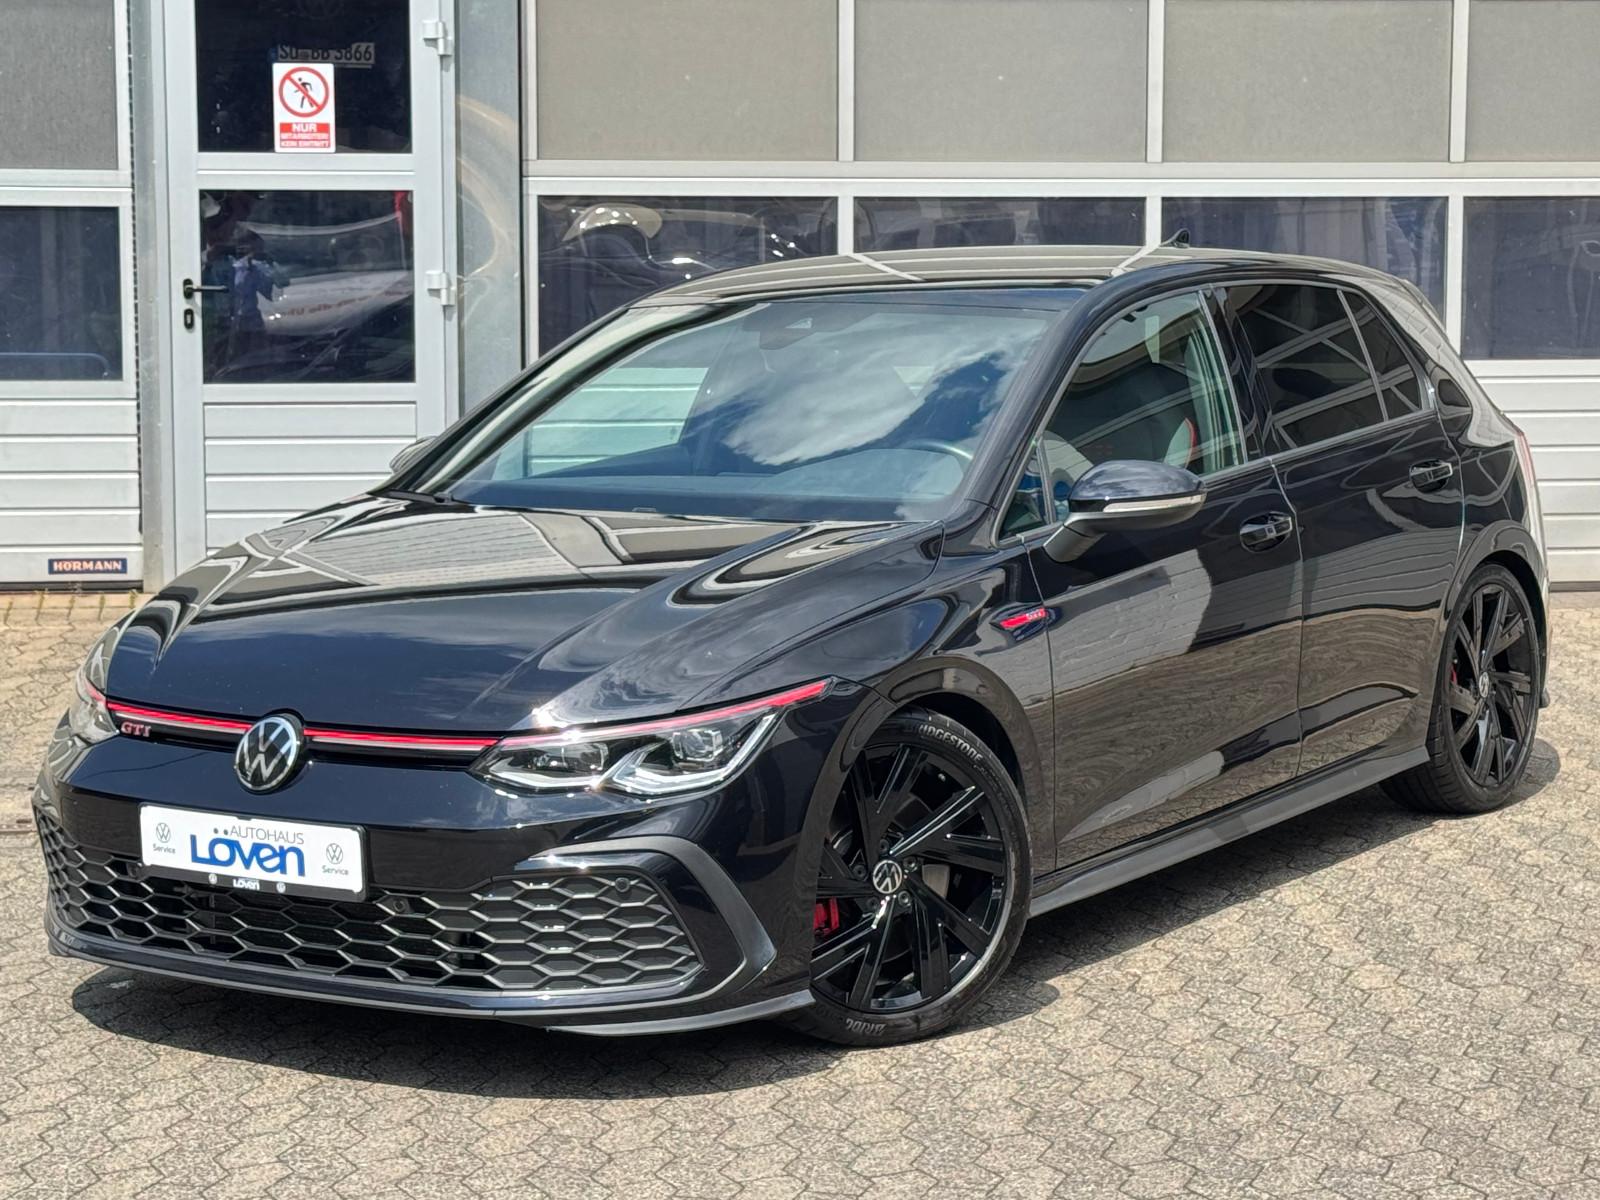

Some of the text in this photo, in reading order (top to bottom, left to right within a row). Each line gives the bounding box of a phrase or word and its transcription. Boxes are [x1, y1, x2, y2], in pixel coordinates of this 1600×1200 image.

[292, 123, 317, 132] NUR
[121, 721, 152, 737] GTI
[912, 724, 984, 762] RIDGESTONE
[230, 825, 304, 845] AUTOHAUS
[152, 843, 176, 855] Service
[322, 865, 349, 876] Service
